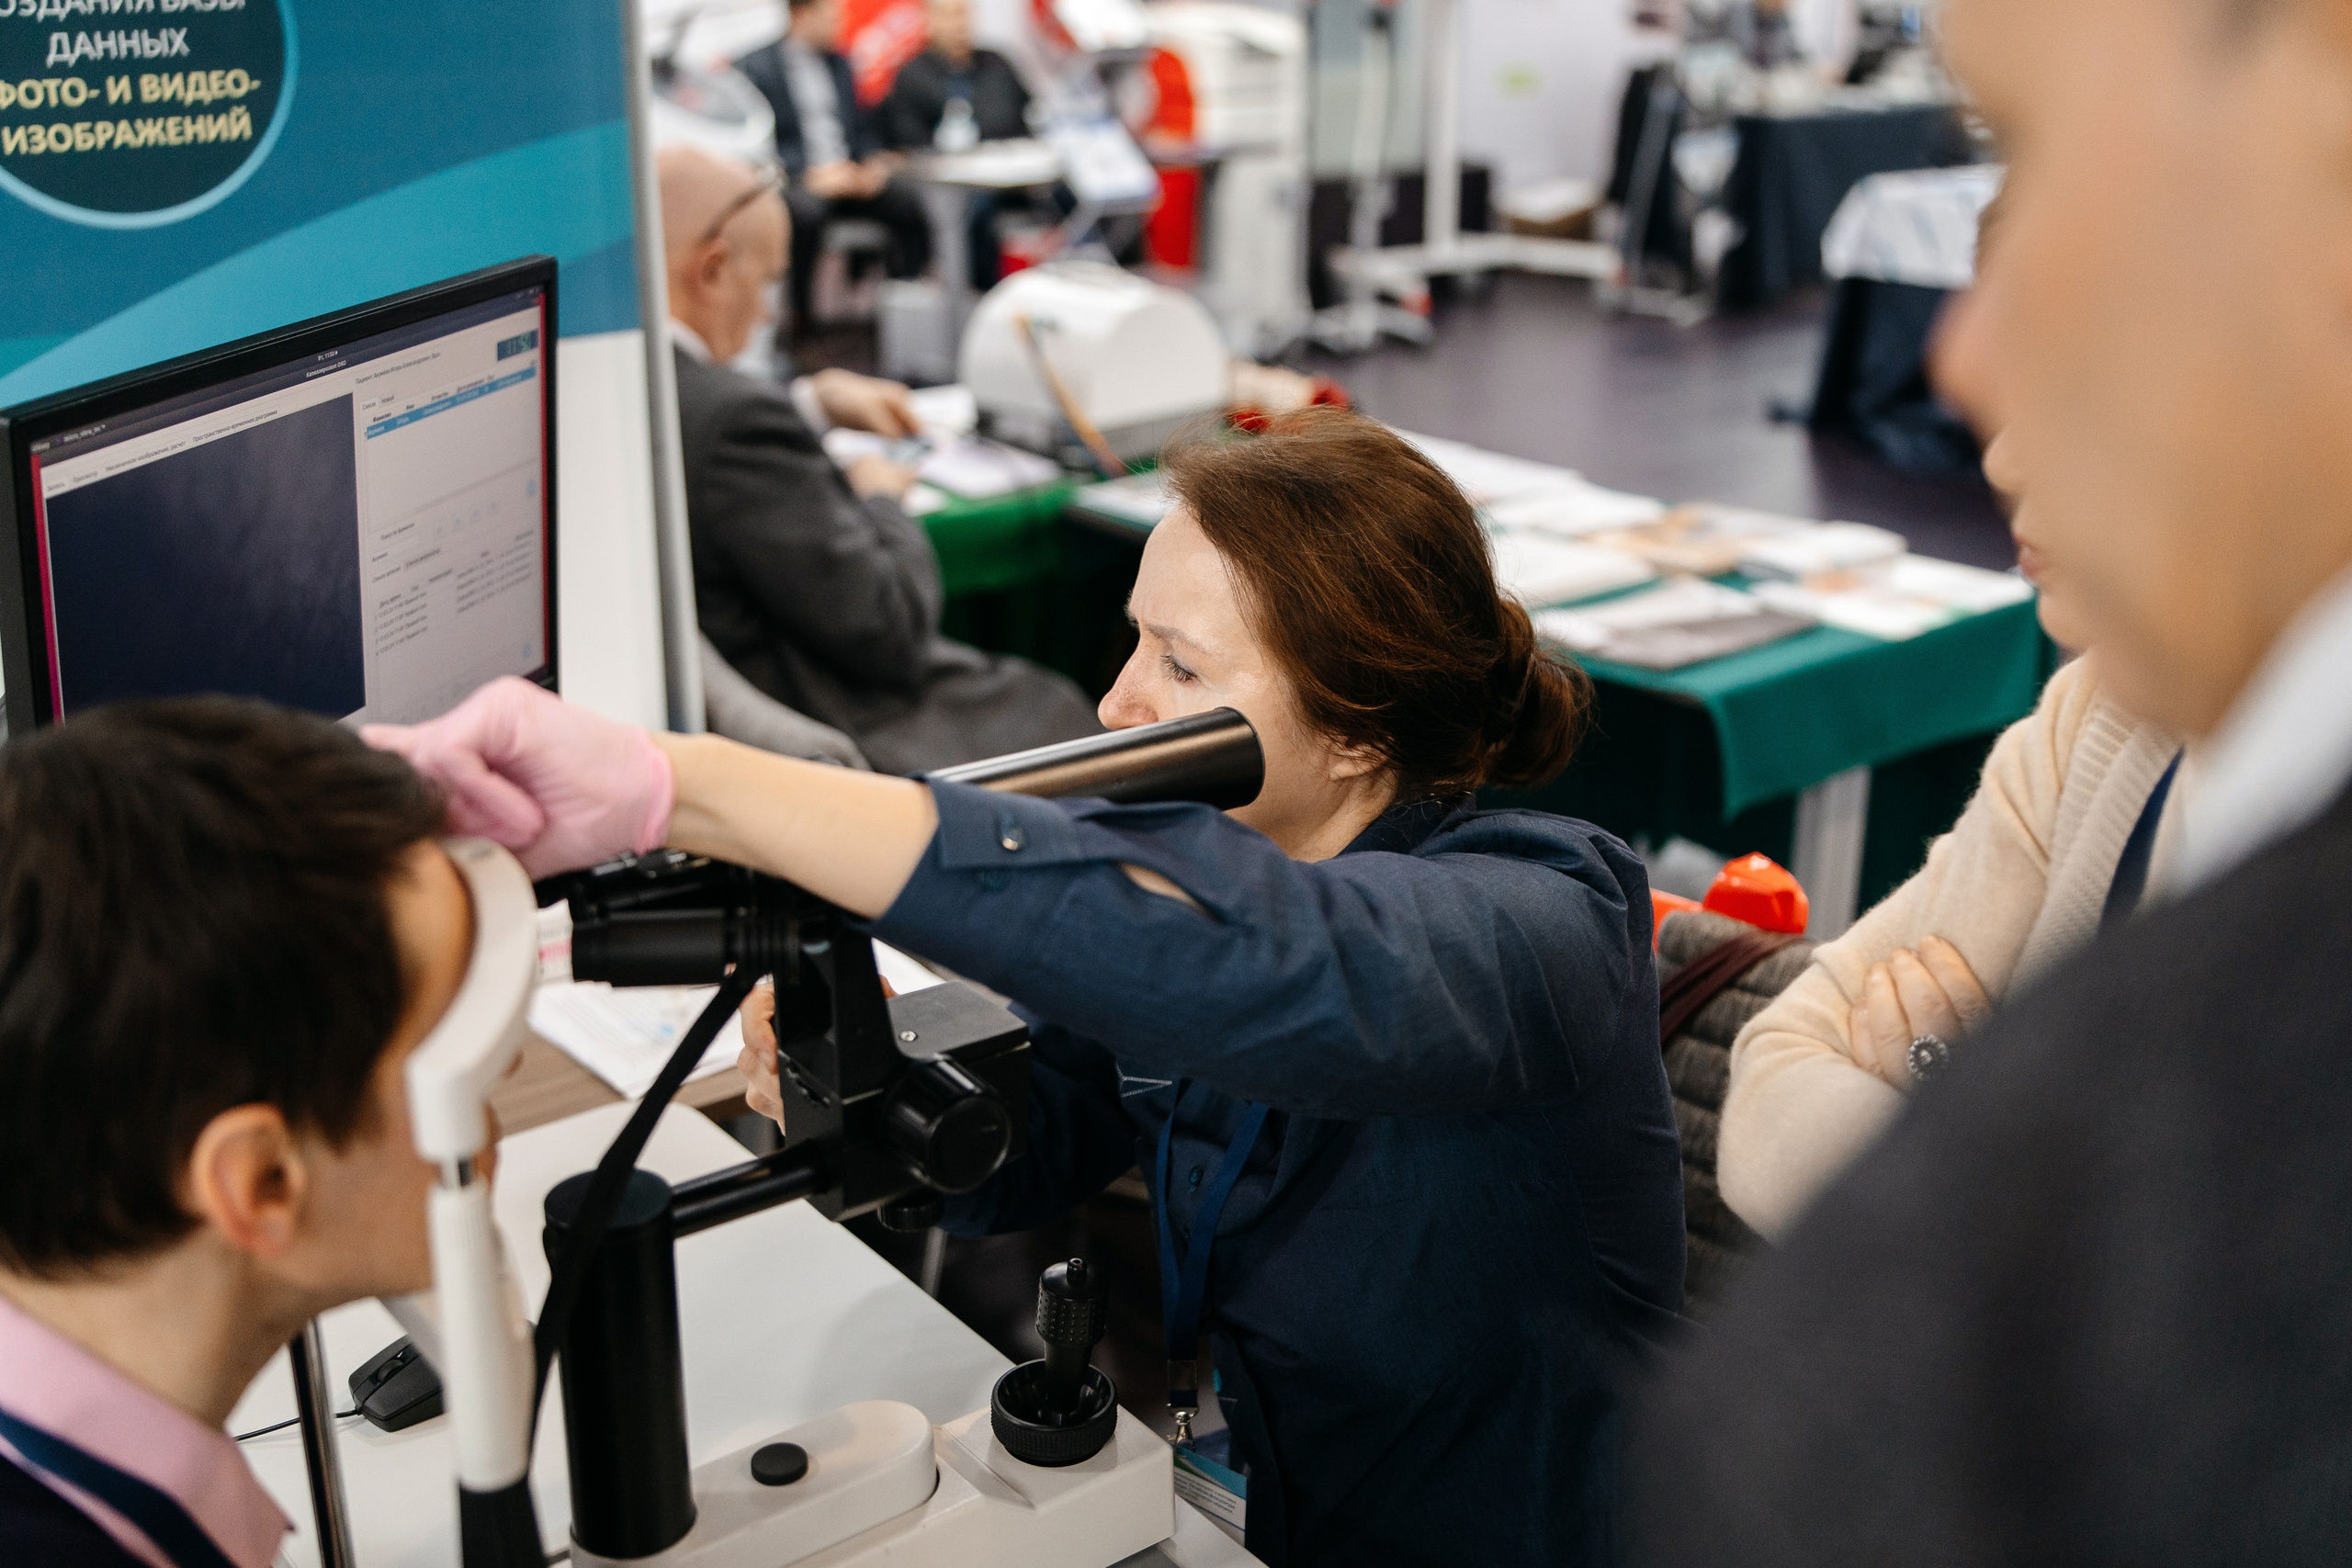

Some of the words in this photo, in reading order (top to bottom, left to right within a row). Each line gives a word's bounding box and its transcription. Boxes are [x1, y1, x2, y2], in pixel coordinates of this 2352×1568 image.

[46, 28, 190, 69] ДАННЫХ
[106, 74, 132, 106] И
[139, 69, 262, 107] ВИДЕО-
[1, 105, 254, 156] ИЗОБРАЖЕНИЙ
[192, 417, 254, 443] Пространственно-временная
[254, 410, 278, 423] диаграмма
